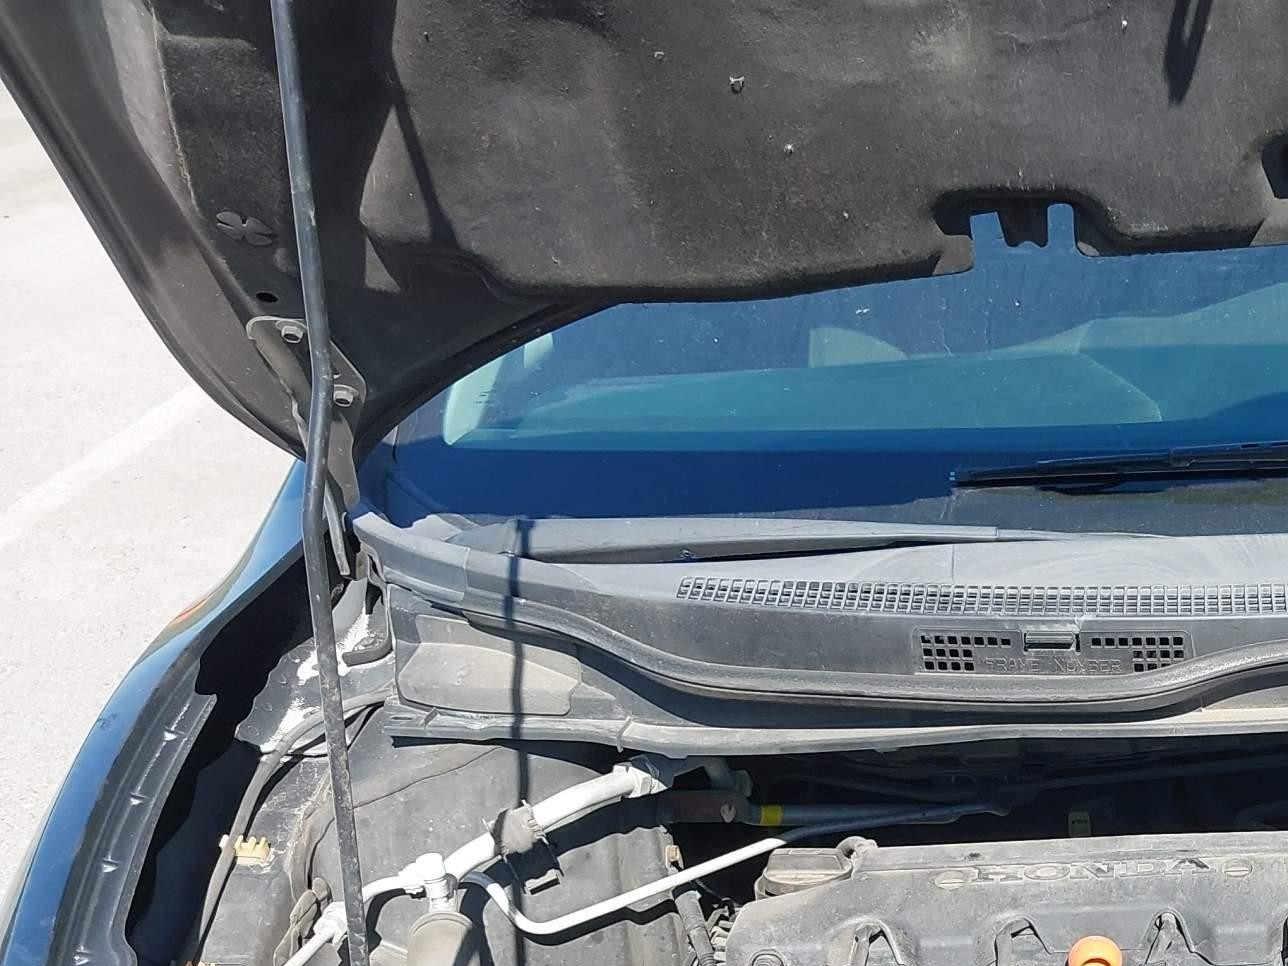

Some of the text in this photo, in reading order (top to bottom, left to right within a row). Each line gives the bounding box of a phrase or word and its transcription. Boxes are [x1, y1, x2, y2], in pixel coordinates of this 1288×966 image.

[985, 656, 1122, 674] FRAME NUMBER
[972, 857, 1217, 883] HONDA
